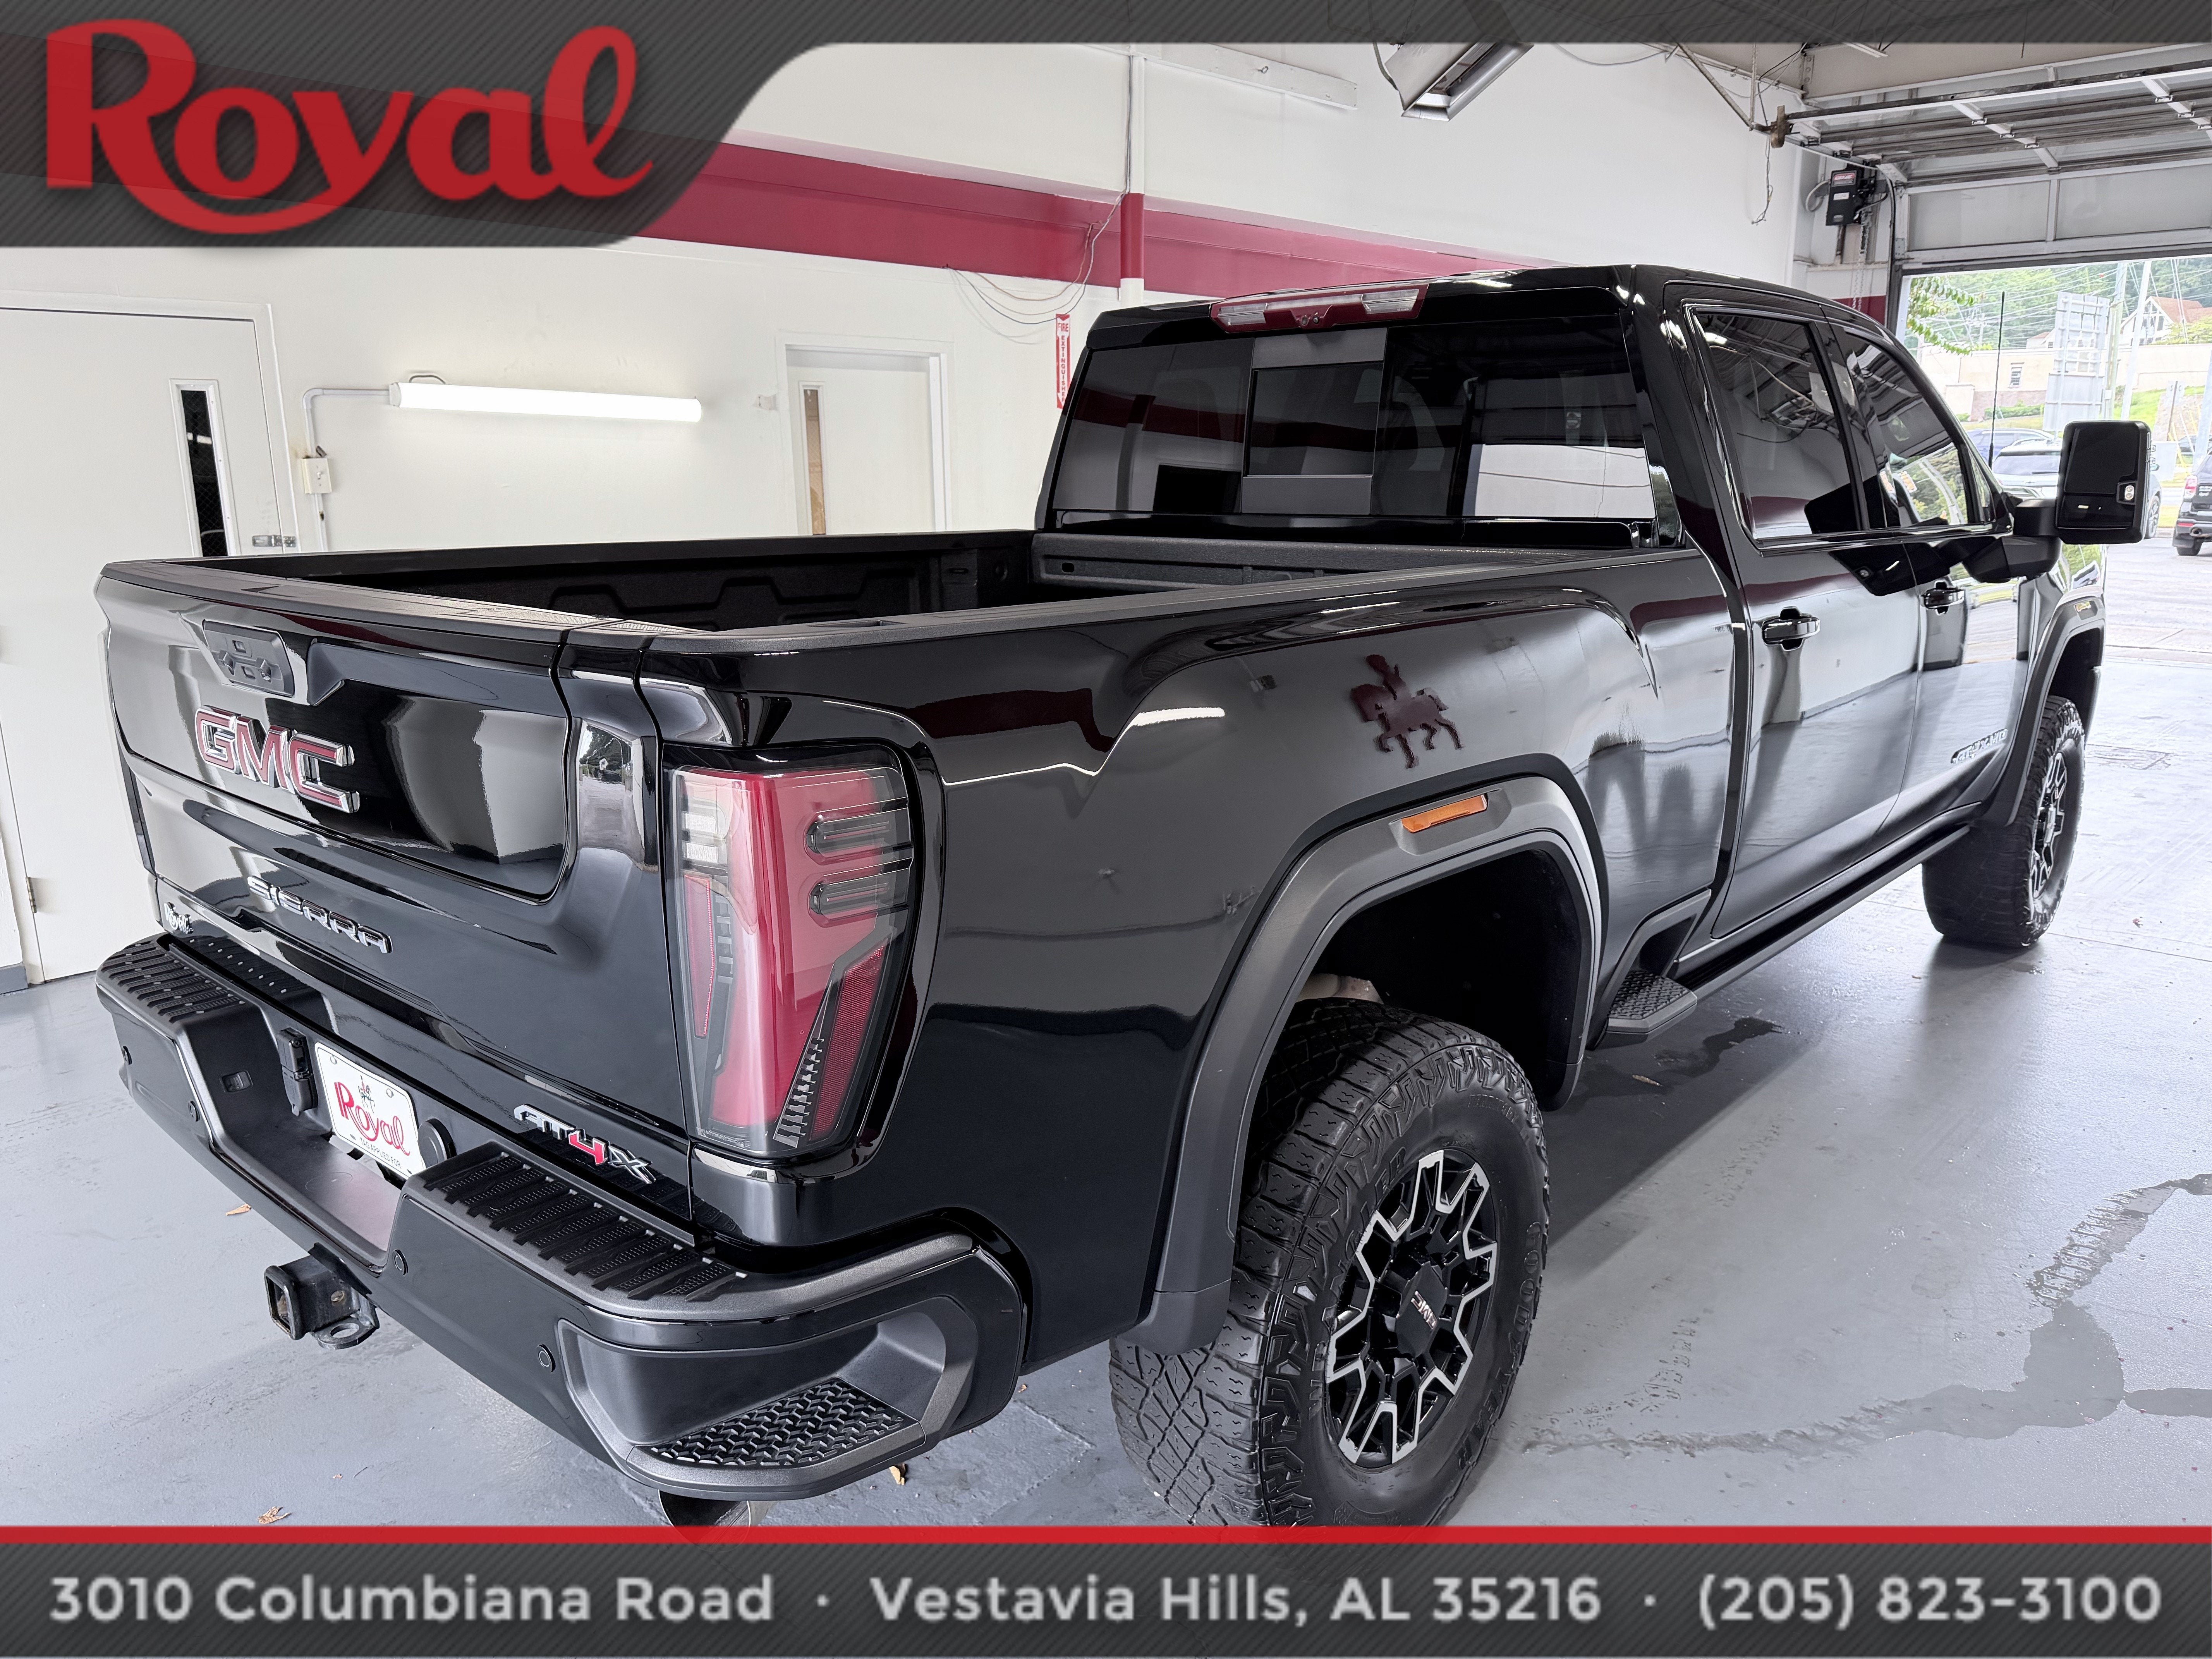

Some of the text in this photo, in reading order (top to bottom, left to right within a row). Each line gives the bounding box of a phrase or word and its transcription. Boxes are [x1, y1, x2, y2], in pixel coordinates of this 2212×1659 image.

[195, 705, 360, 813] GMC
[247, 875, 393, 954] SIERRA
[334, 1082, 410, 1156] Royal
[360, 1137, 402, 1169] TAG APPLIED FOR
[514, 1103, 658, 1184] AT4X
[1411, 1290, 1437, 1329] GMC
